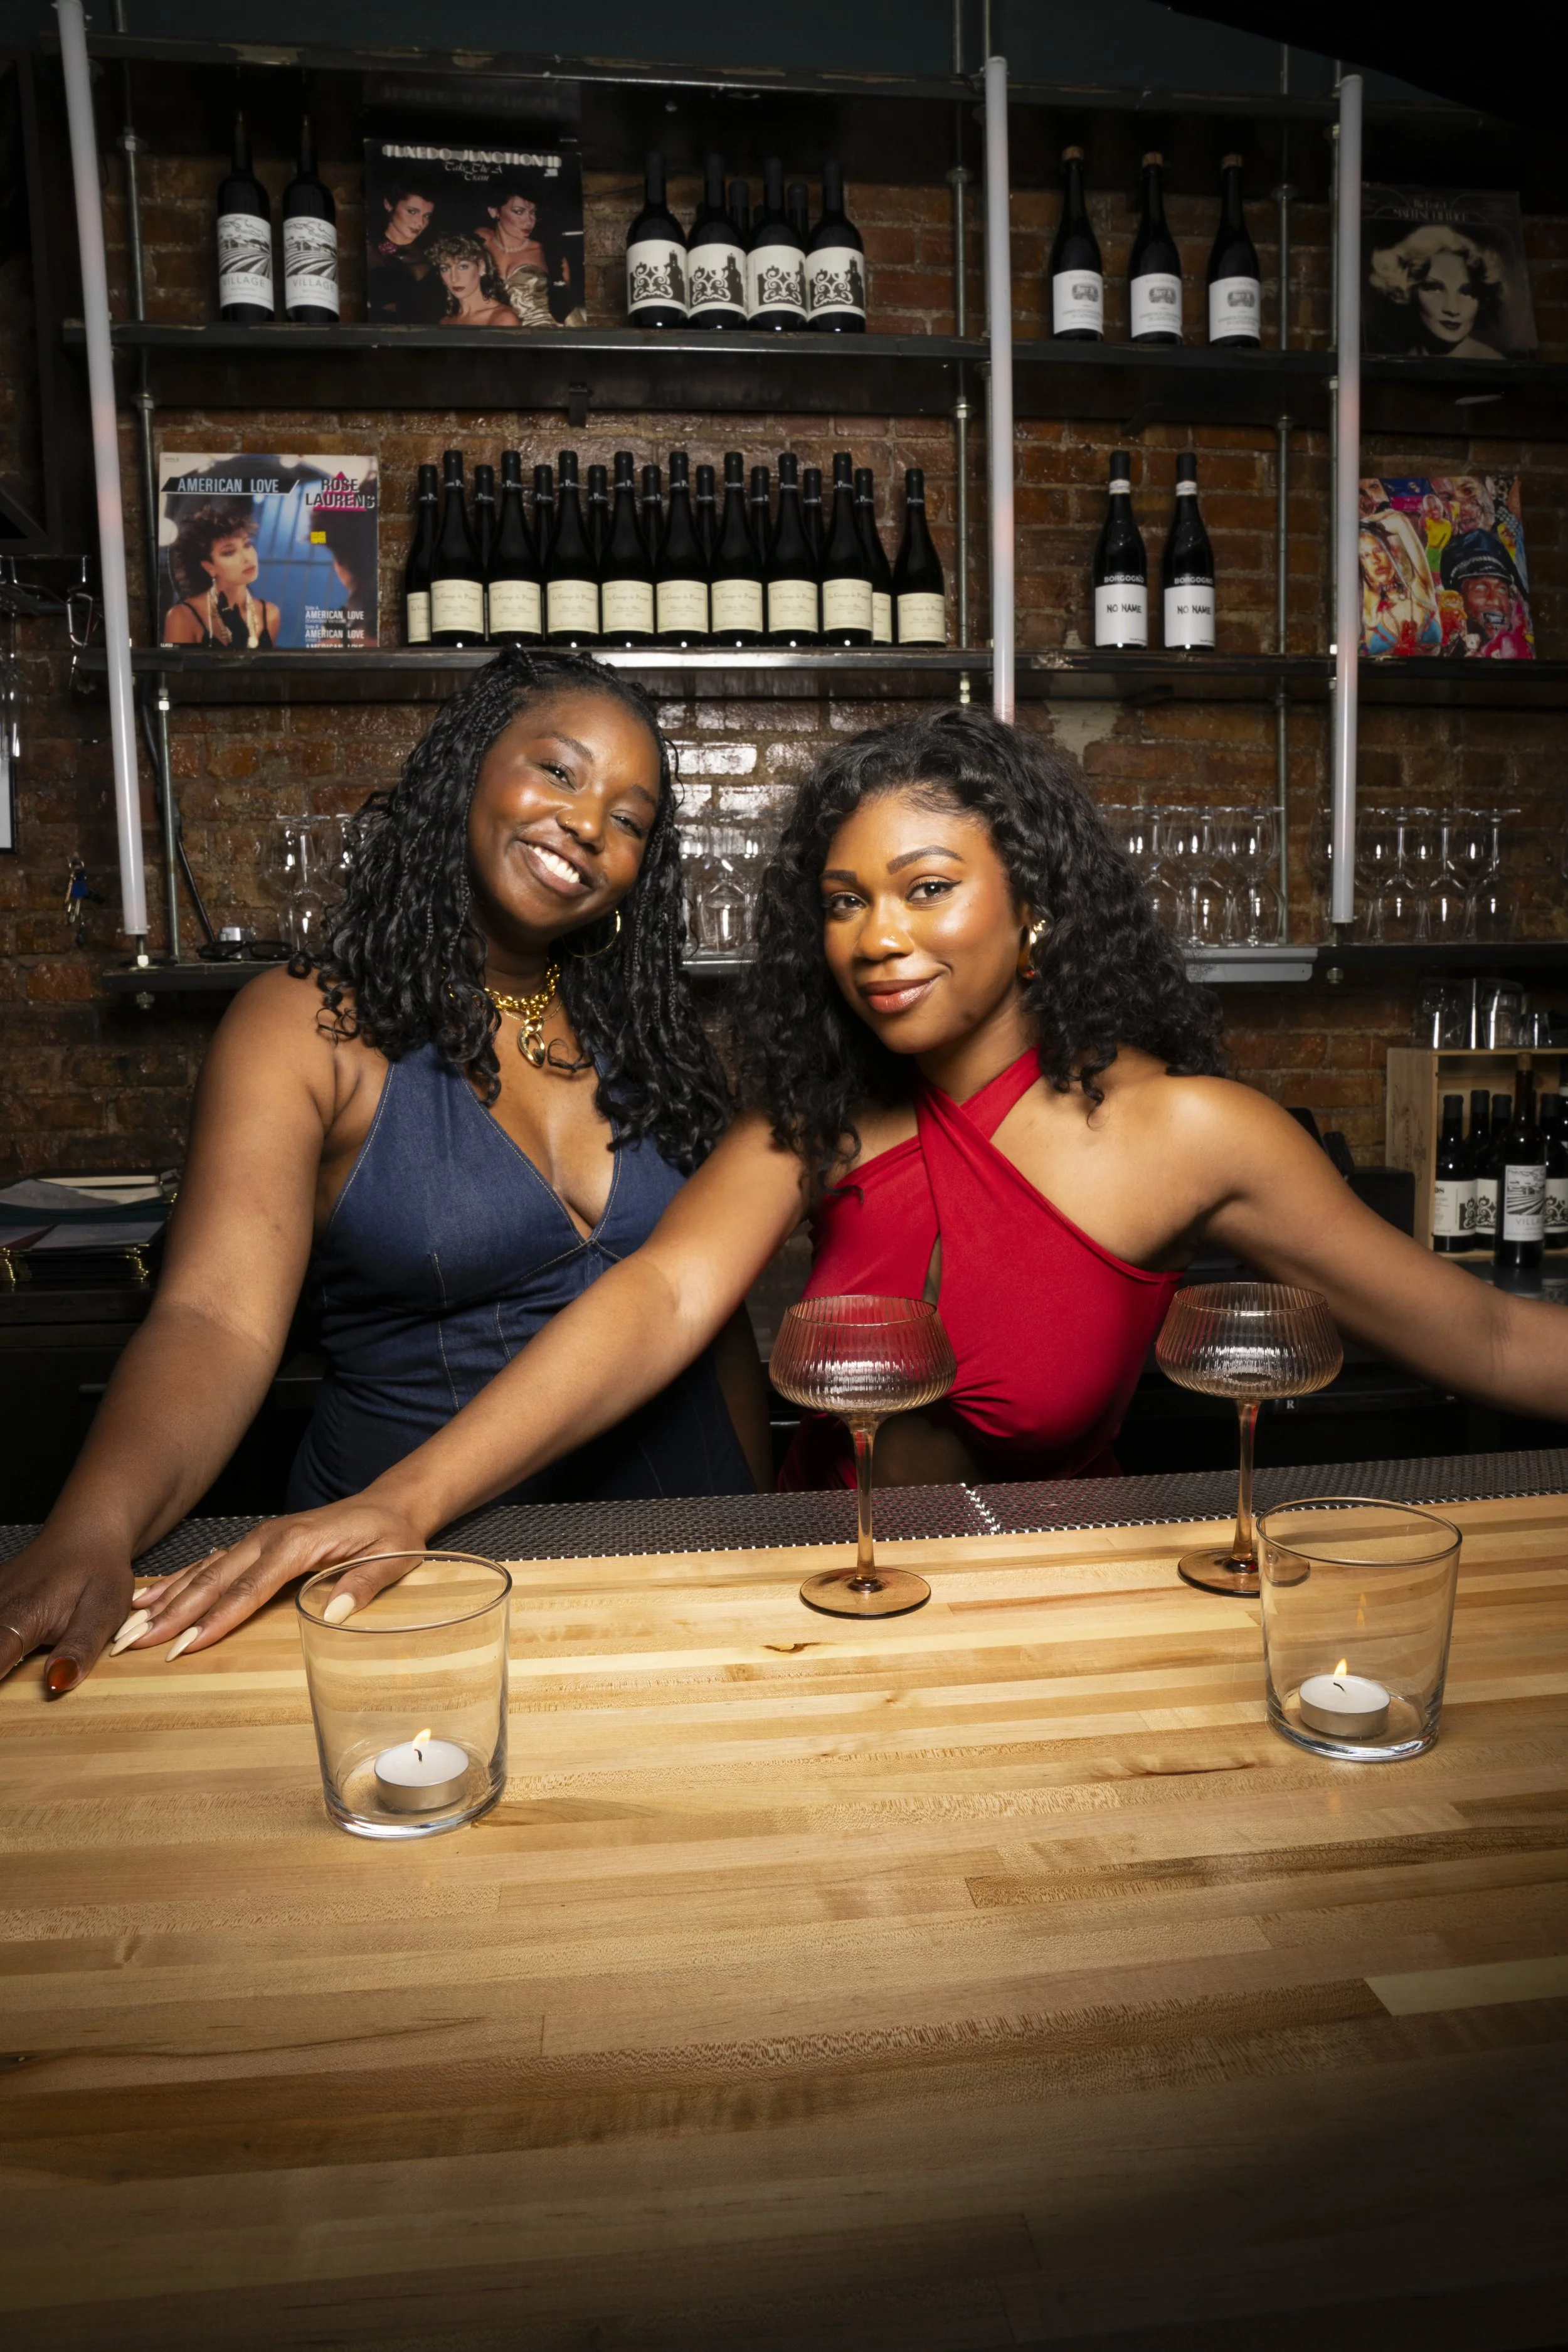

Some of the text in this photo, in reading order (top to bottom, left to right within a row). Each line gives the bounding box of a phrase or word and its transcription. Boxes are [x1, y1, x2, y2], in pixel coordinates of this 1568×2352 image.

[382, 144, 452, 161] TUXEDO
[462, 149, 545, 166] JUNCTION
[222, 276, 266, 289] VILLAGE
[292, 279, 336, 293] VILLAGE
[177, 478, 280, 493] AMERICAN LOVE
[322, 479, 360, 493] ROSE
[305, 493, 376, 509] LAURENS
[305, 610, 364, 620] AMERICAN LOVE
[1106, 603, 1143, 614] NO NAME
[1177, 605, 1212, 615] NO NAME
[305, 629, 364, 639] AMERICAN LOVE
[1286, 1399, 1295, 1410] R
